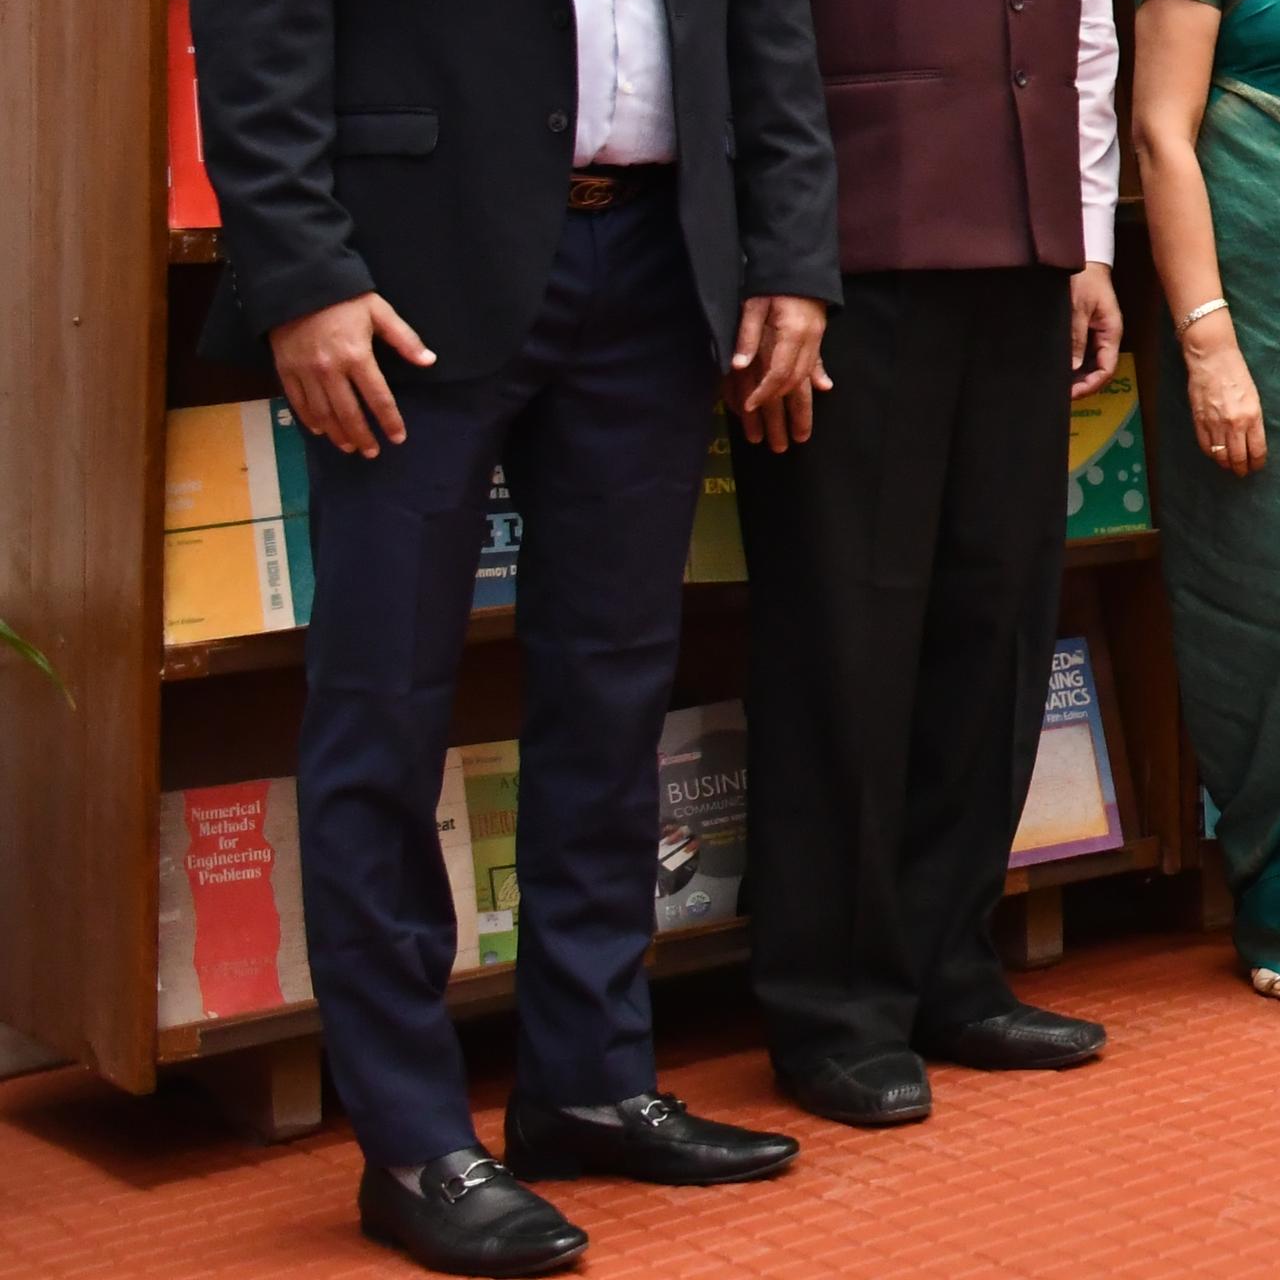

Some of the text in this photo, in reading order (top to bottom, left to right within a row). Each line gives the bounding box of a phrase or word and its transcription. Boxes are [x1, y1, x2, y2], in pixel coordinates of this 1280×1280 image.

[191, 800, 261, 822] Numerical
[199, 818, 256, 837] Methods
[218, 835, 240, 850] for
[187, 847, 272, 871] Engineering
[199, 865, 262, 886] Problems
